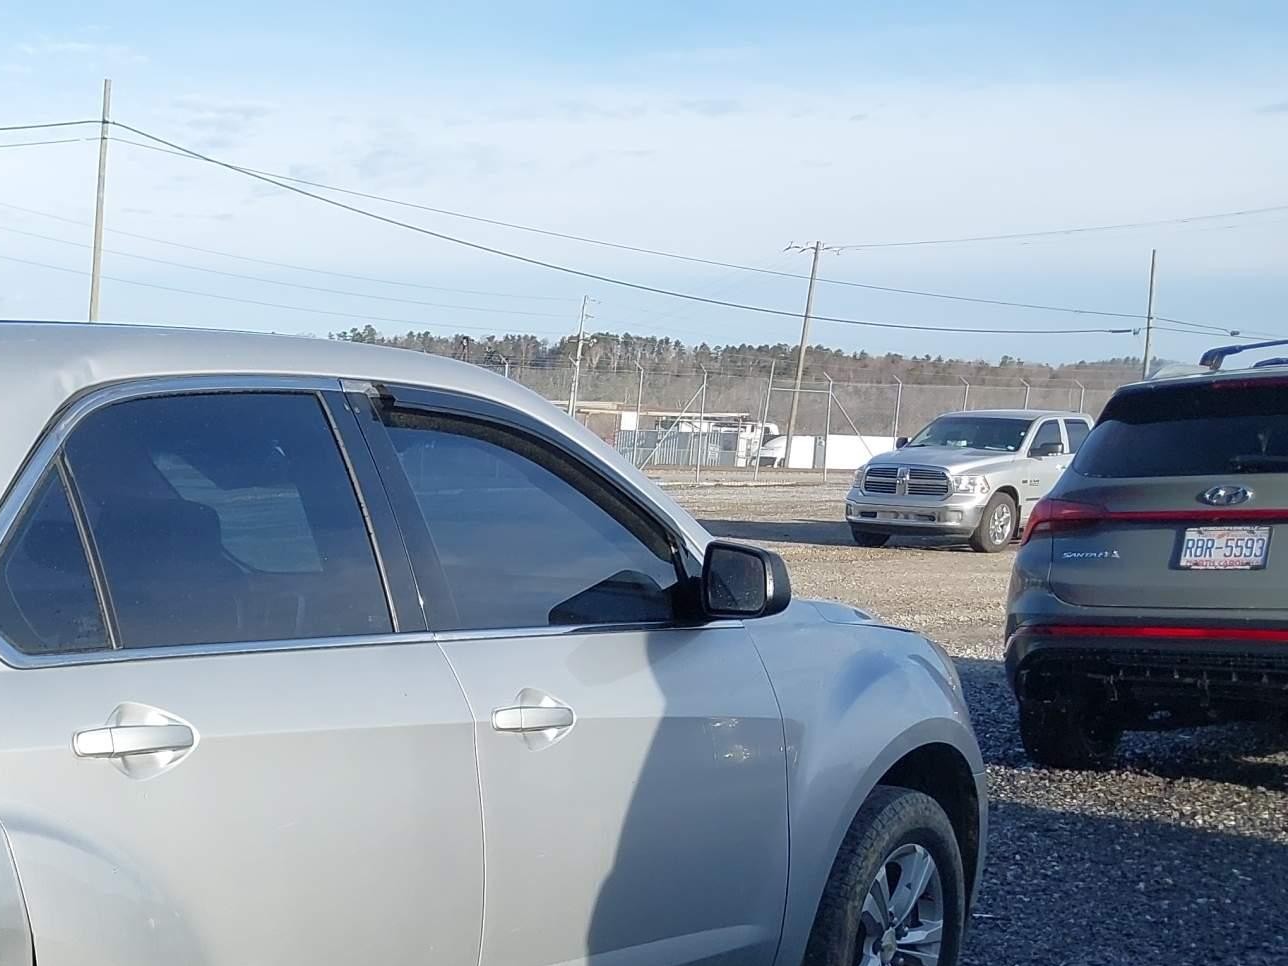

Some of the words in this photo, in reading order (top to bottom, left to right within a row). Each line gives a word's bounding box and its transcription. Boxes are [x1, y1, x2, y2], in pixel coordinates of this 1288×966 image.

[1184, 538, 1266, 558] RBR-5593
[1186, 559, 1216, 567] RTH
[1217, 559, 1262, 567] CARO
